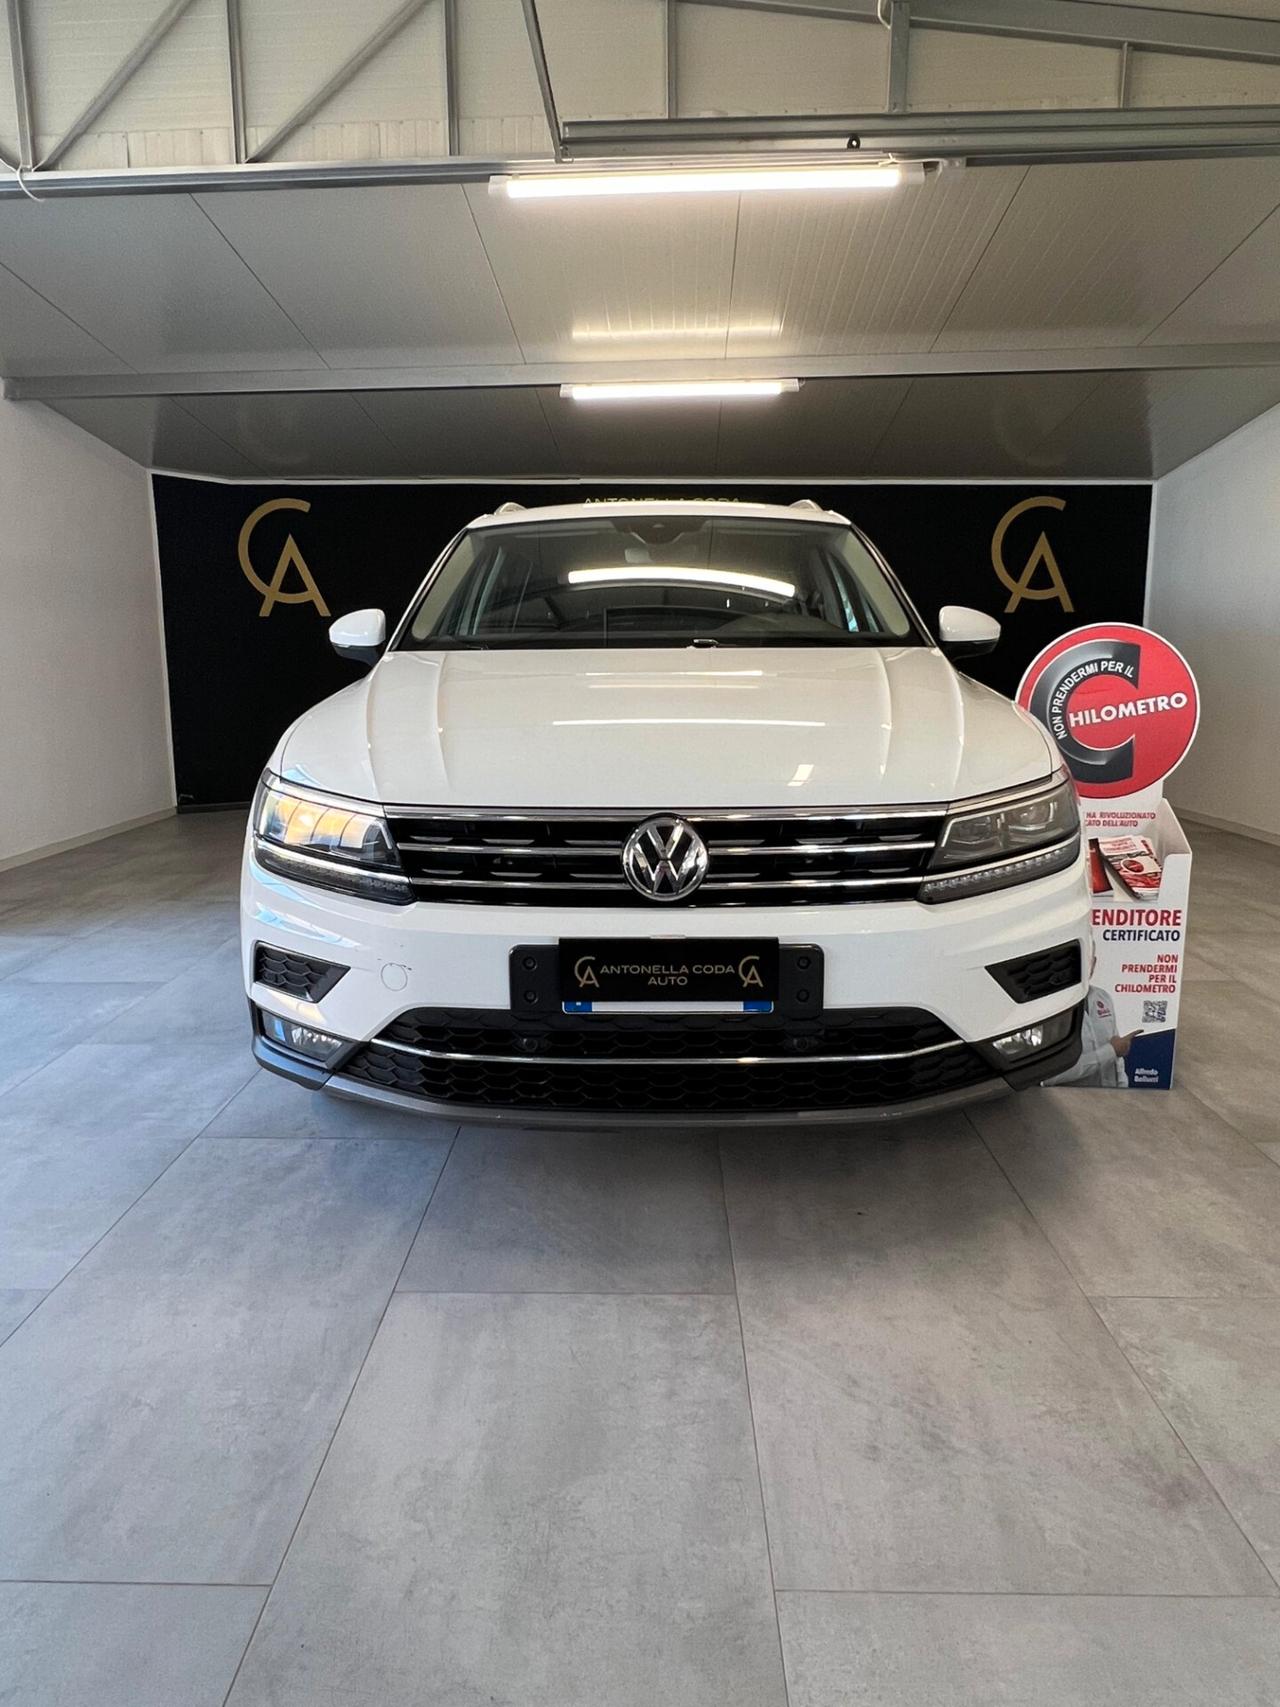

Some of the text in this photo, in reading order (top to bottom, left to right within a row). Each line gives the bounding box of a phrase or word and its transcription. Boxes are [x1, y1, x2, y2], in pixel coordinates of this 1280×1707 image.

[1051, 660, 1135, 740] NON PRENDERMI PER IL
[1099, 811, 1156, 819] RIVOLUZIONATO
[1091, 909, 1182, 926] ENDITORE
[1102, 929, 1180, 941] CERTIFICATO
[1157, 954, 1179, 963] NON
[600, 965, 689, 974] ANTONELLA
[692, 965, 735, 974] CODA
[1121, 964, 1178, 973] PRENDERMI
[647, 976, 688, 986] AUTO
[1148, 975, 1177, 983] PER IL
[1114, 984, 1176, 993] CHILOMETRO
